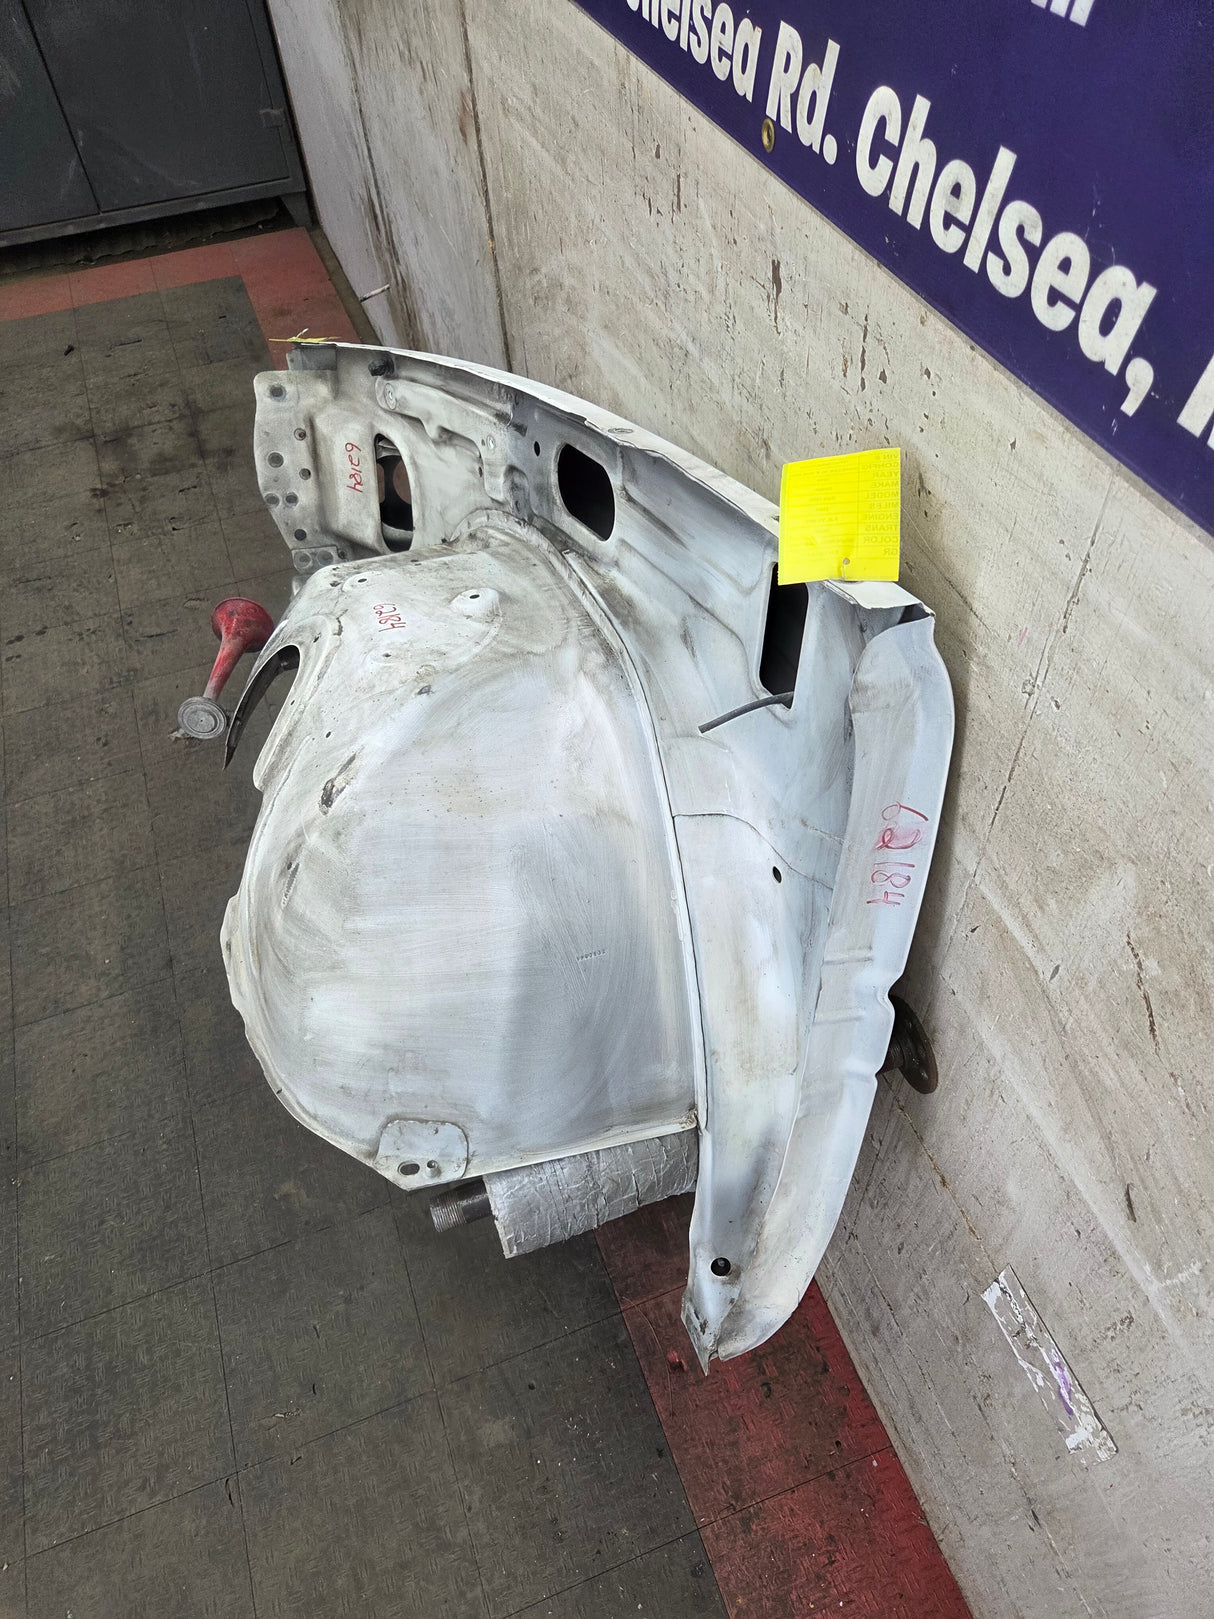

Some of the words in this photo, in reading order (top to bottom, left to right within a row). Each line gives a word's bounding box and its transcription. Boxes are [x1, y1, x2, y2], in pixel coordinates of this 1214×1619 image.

[626, 0, 763, 103] elsea
[765, 20, 841, 165] Rd.
[855, 85, 1158, 417] Chelsea,
[345, 442, 363, 493] 62184
[373, 603, 407, 632] 62184
[866, 801, 929, 906] 62184
